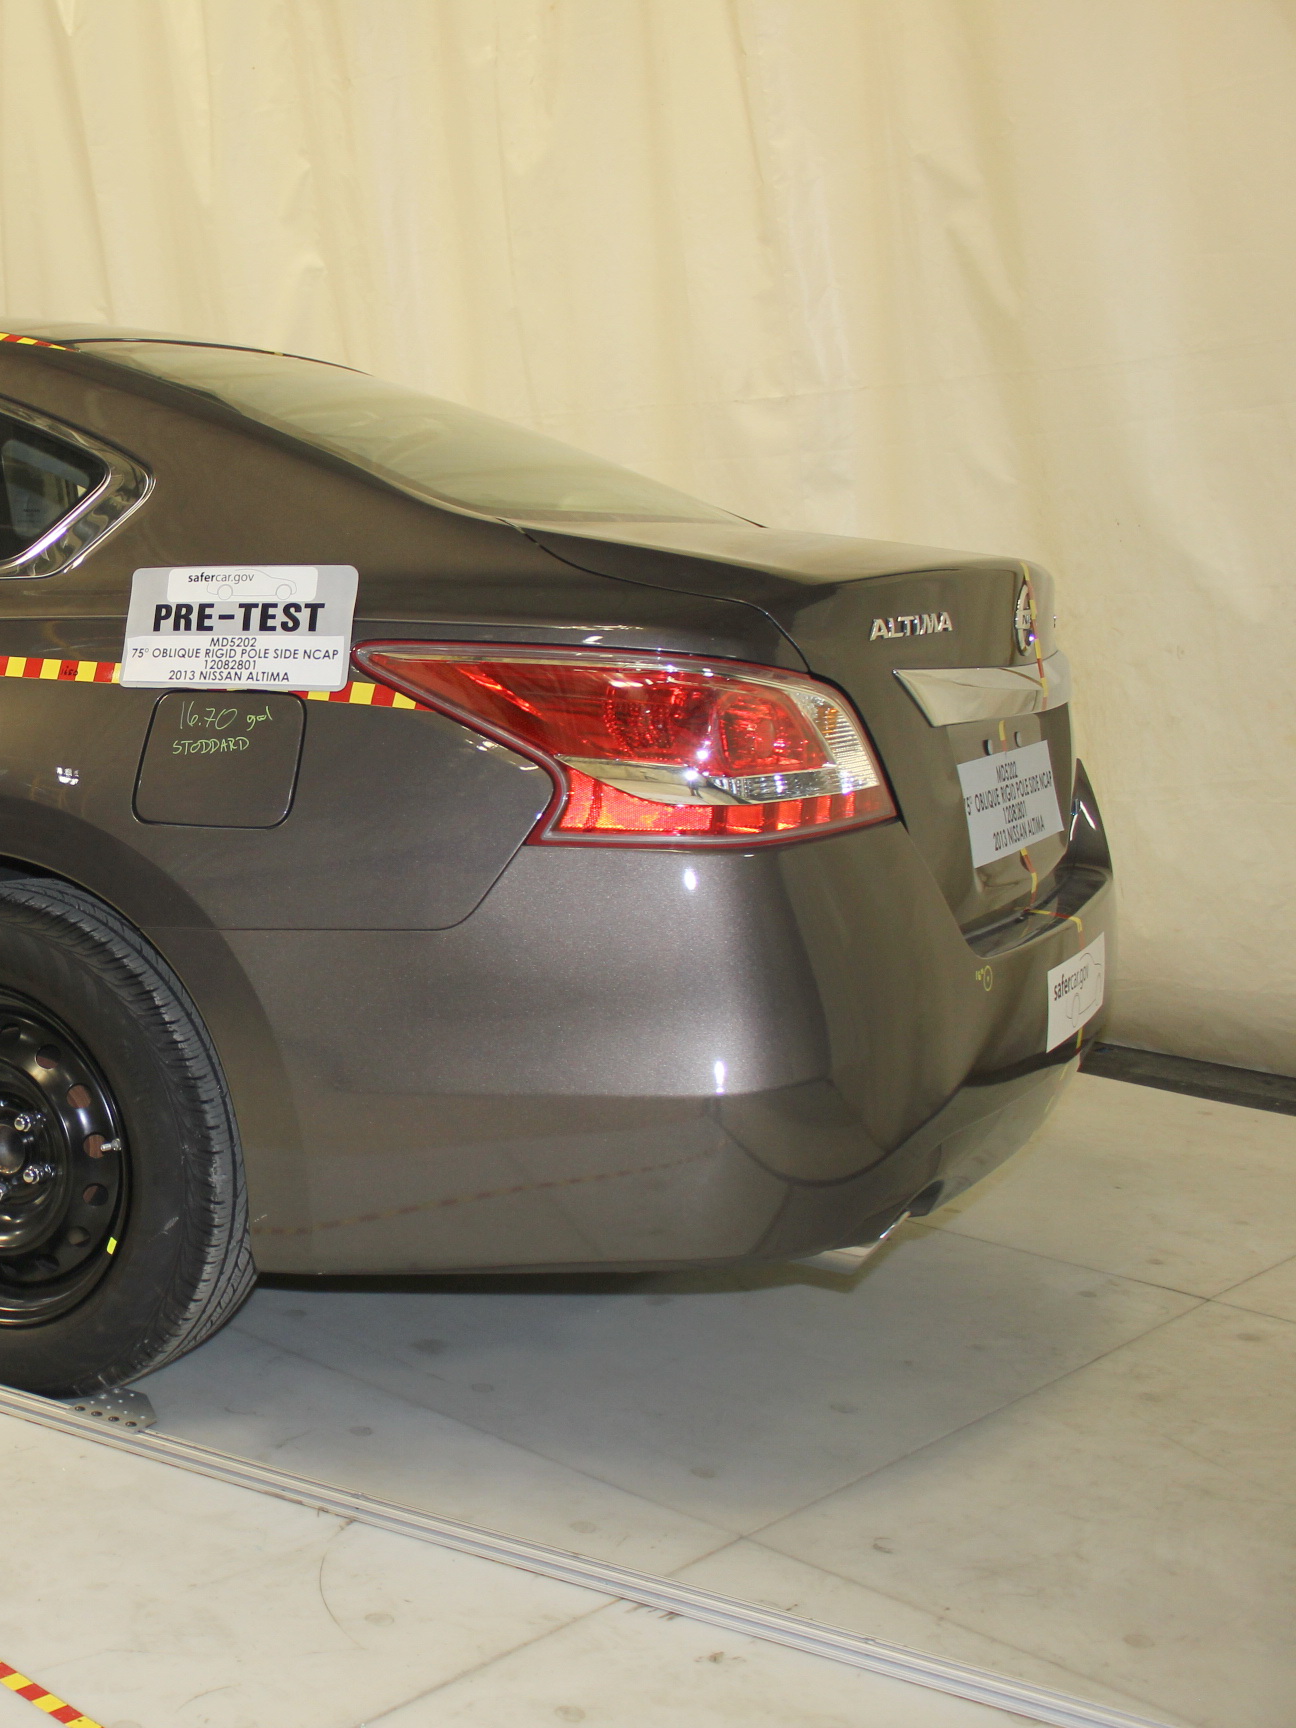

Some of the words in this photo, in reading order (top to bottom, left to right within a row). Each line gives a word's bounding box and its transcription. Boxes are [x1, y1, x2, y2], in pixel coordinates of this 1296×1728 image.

[187, 571, 255, 584] safercar.gov
[152, 602, 326, 632] PRE-TEST
[869, 611, 953, 641] ALTIMA
[151, 648, 201, 660] OBLIQUE
[204, 648, 238, 659] RIGID
[240, 649, 271, 659] POLE
[273, 649, 299, 660] SIDE
[302, 649, 339, 660] NCAP
[209, 637, 257, 648] MD5202
[168, 670, 196, 680] 2013
[198, 671, 244, 682] NISSAN
[246, 671, 290, 682] ALTIMA
[203, 660, 257, 670] 12082801
[179, 700, 238, 730] 16.70
[172, 736, 250, 755] STODDARD
[974, 787, 1001, 813] OBLIQUE
[1016, 778, 1030, 799] POLE
[1029, 775, 1041, 794] SIDE
[1038, 770, 1053, 791] NCAP
[993, 828, 1008, 851] 2013
[1007, 821, 1028, 845] NISSAN
[1027, 815, 1046, 837] ALTIMA
[1053, 963, 1090, 1001] safercar.gov
